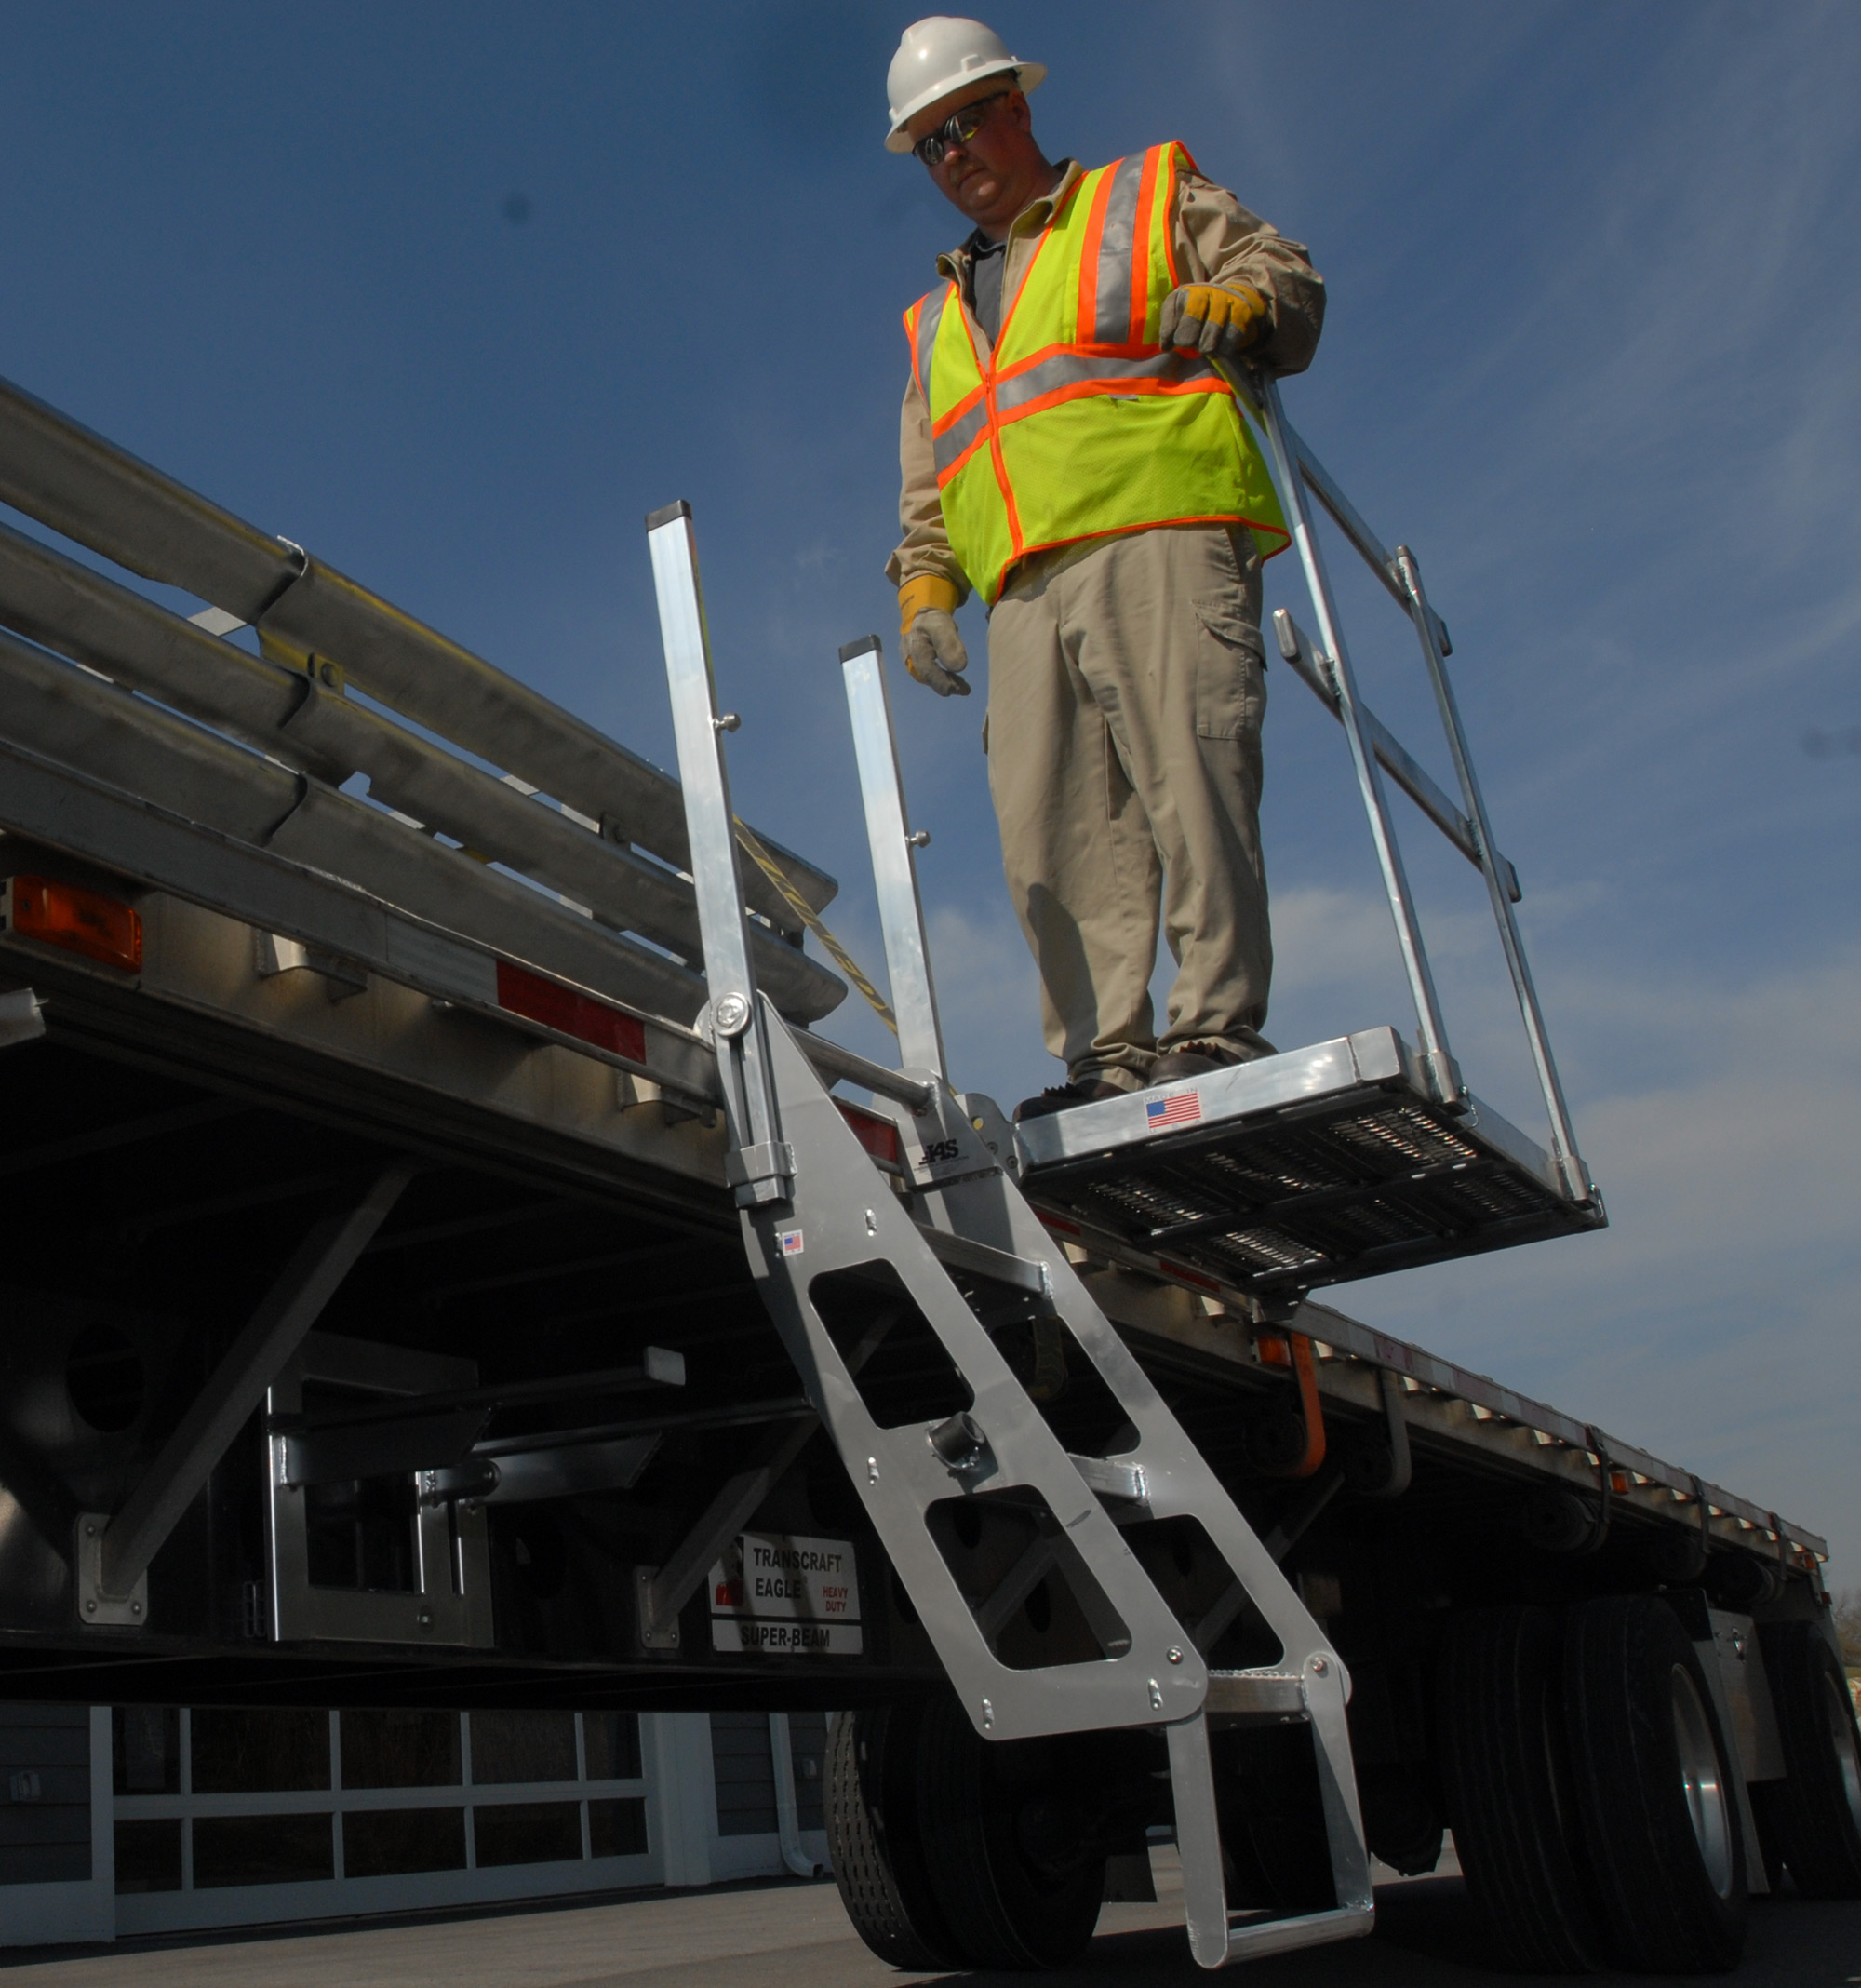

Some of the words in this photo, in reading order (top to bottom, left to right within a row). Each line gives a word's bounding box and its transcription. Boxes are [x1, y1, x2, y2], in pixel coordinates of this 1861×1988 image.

[753, 1547, 842, 1573] TRANSCRAFT
[755, 1578, 802, 1599] EAGLE
[823, 1586, 849, 1599] HEAVY
[825, 1601, 847, 1612] DUTY
[742, 1626, 830, 1647] SUPER-BEAM
